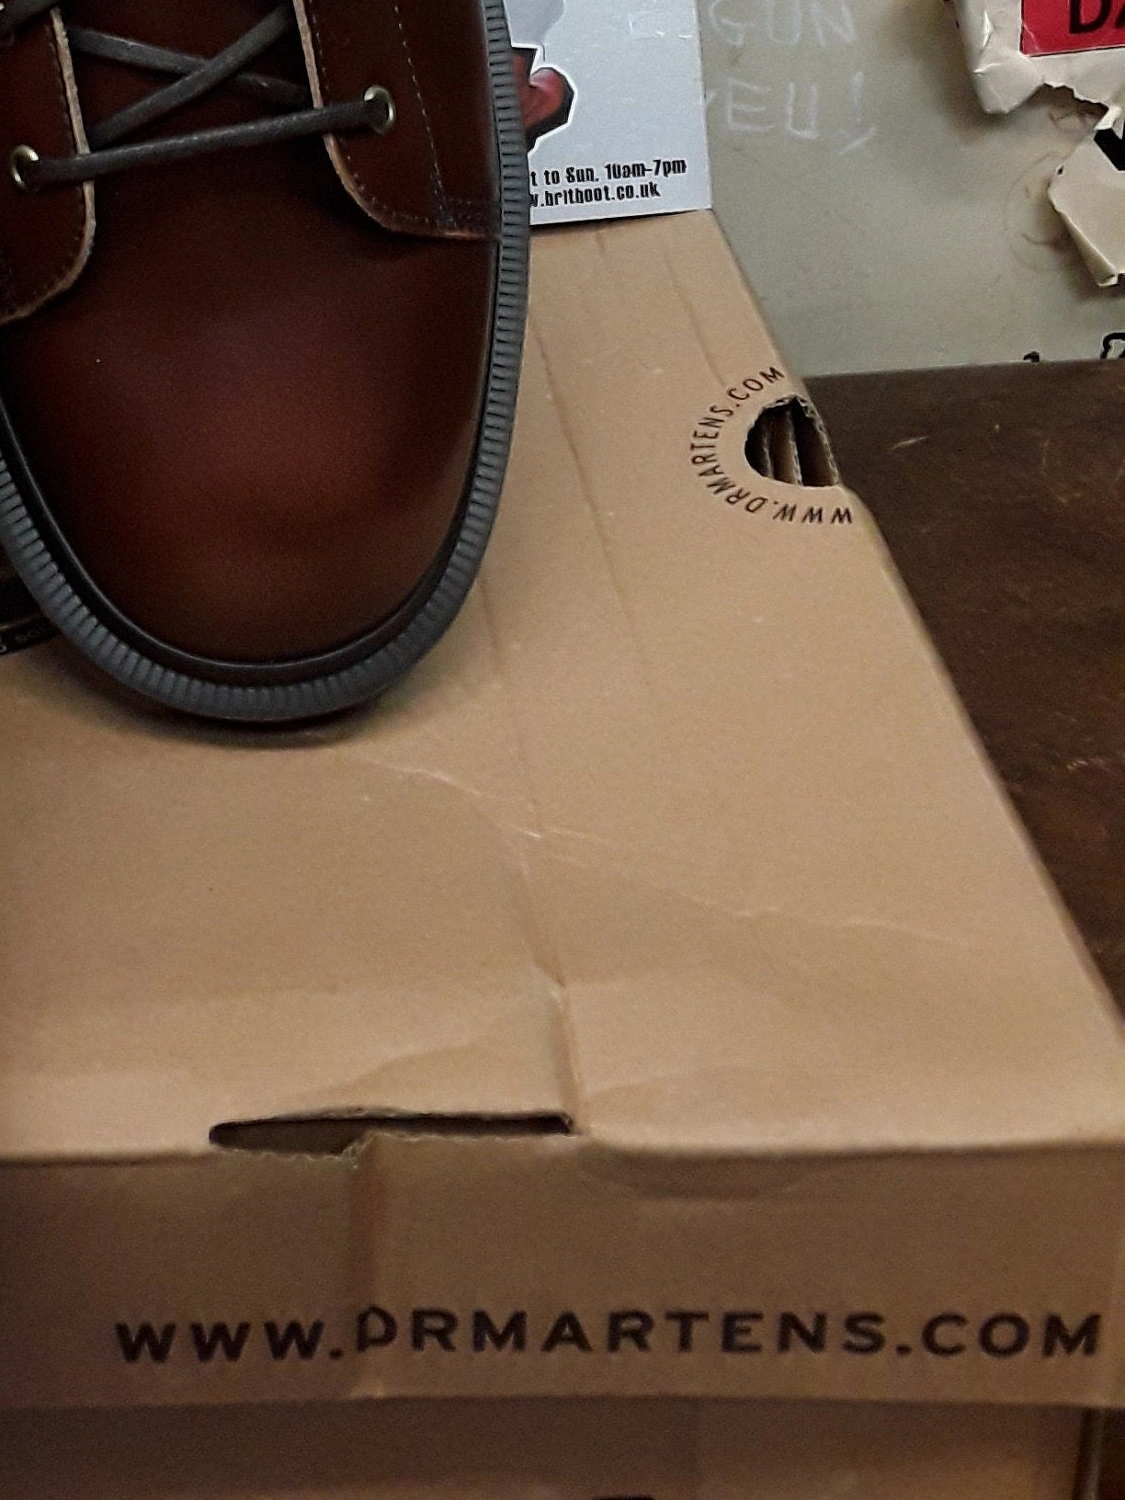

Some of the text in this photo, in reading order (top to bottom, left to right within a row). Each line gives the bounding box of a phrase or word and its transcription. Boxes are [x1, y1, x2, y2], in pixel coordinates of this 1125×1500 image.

[544, 169, 560, 185] to
[566, 166, 599, 183] Sun.
[114, 1304, 1102, 1364] WWW.DRMARTENS.COM
